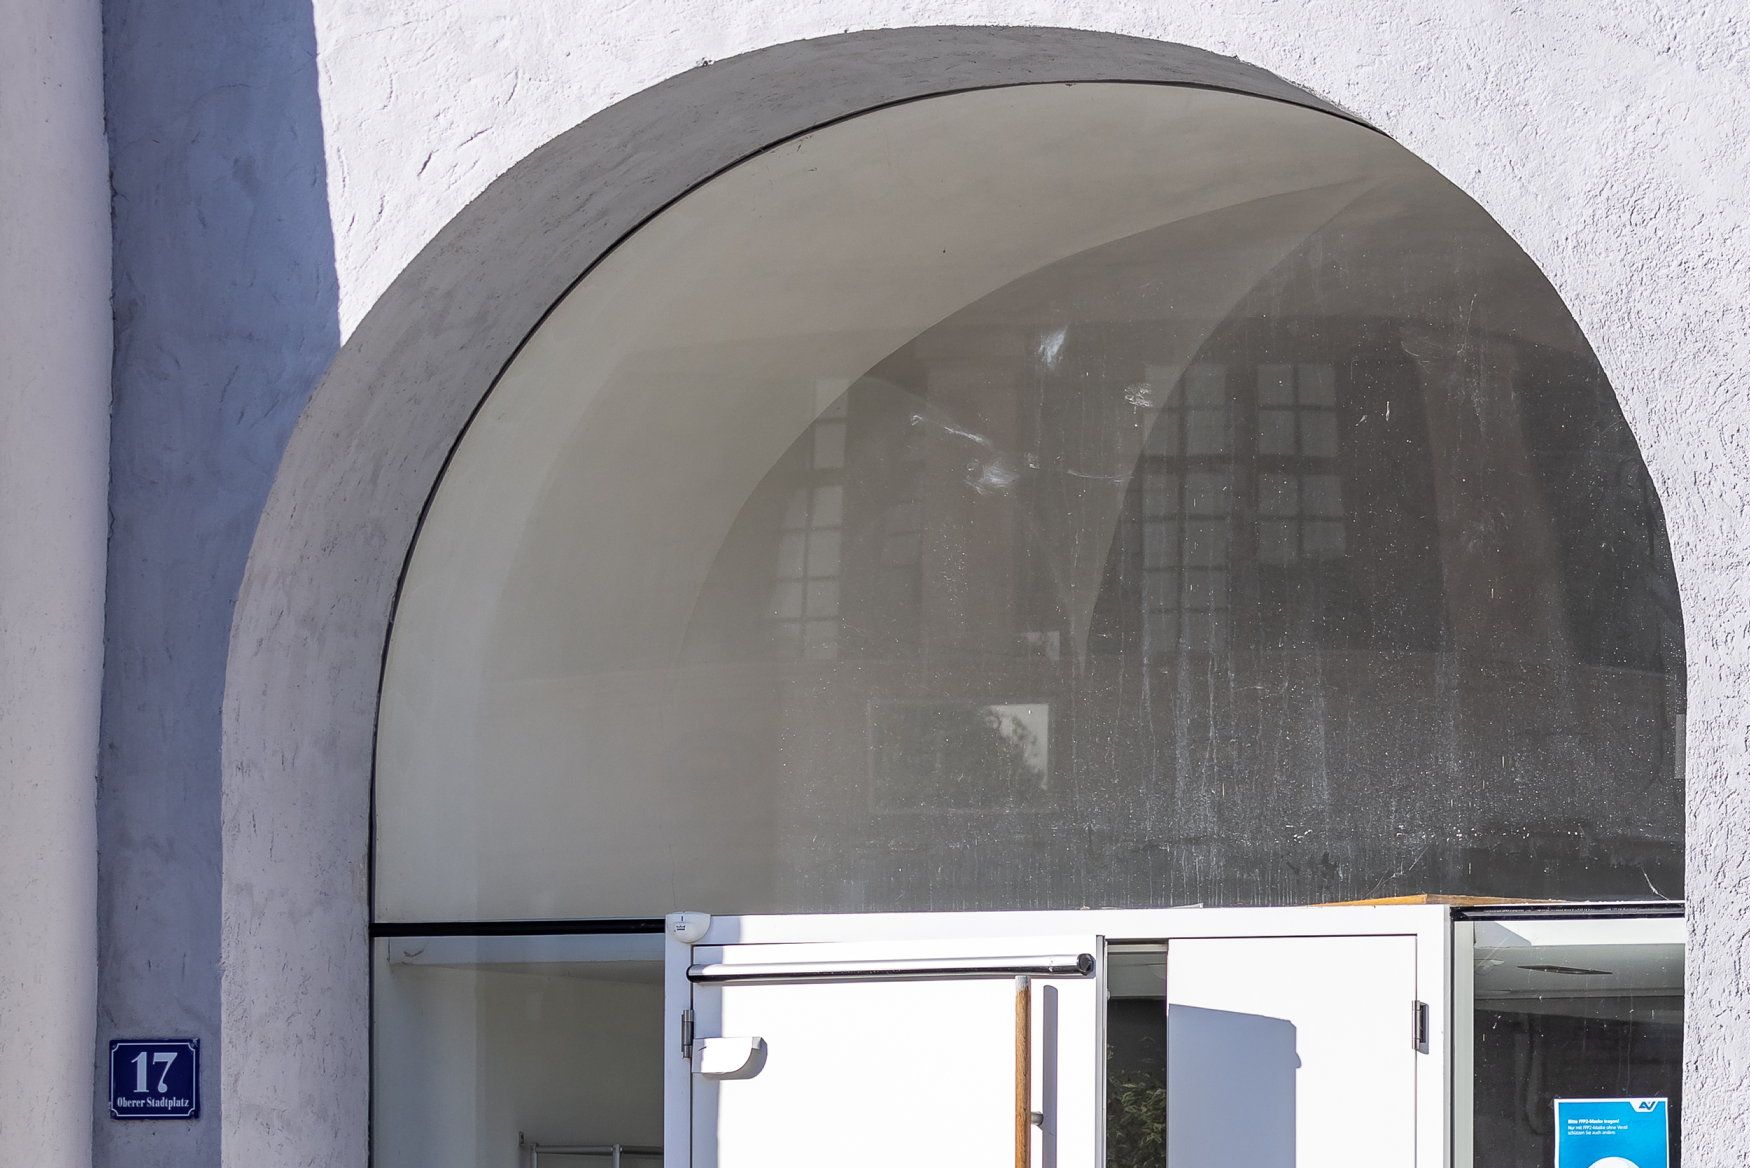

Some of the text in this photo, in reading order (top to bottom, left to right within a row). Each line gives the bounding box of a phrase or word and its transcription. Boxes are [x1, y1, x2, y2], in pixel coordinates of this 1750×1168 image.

[131, 1051, 178, 1093] 17
[117, 1096, 190, 1110] Oberer Stadtplatz
